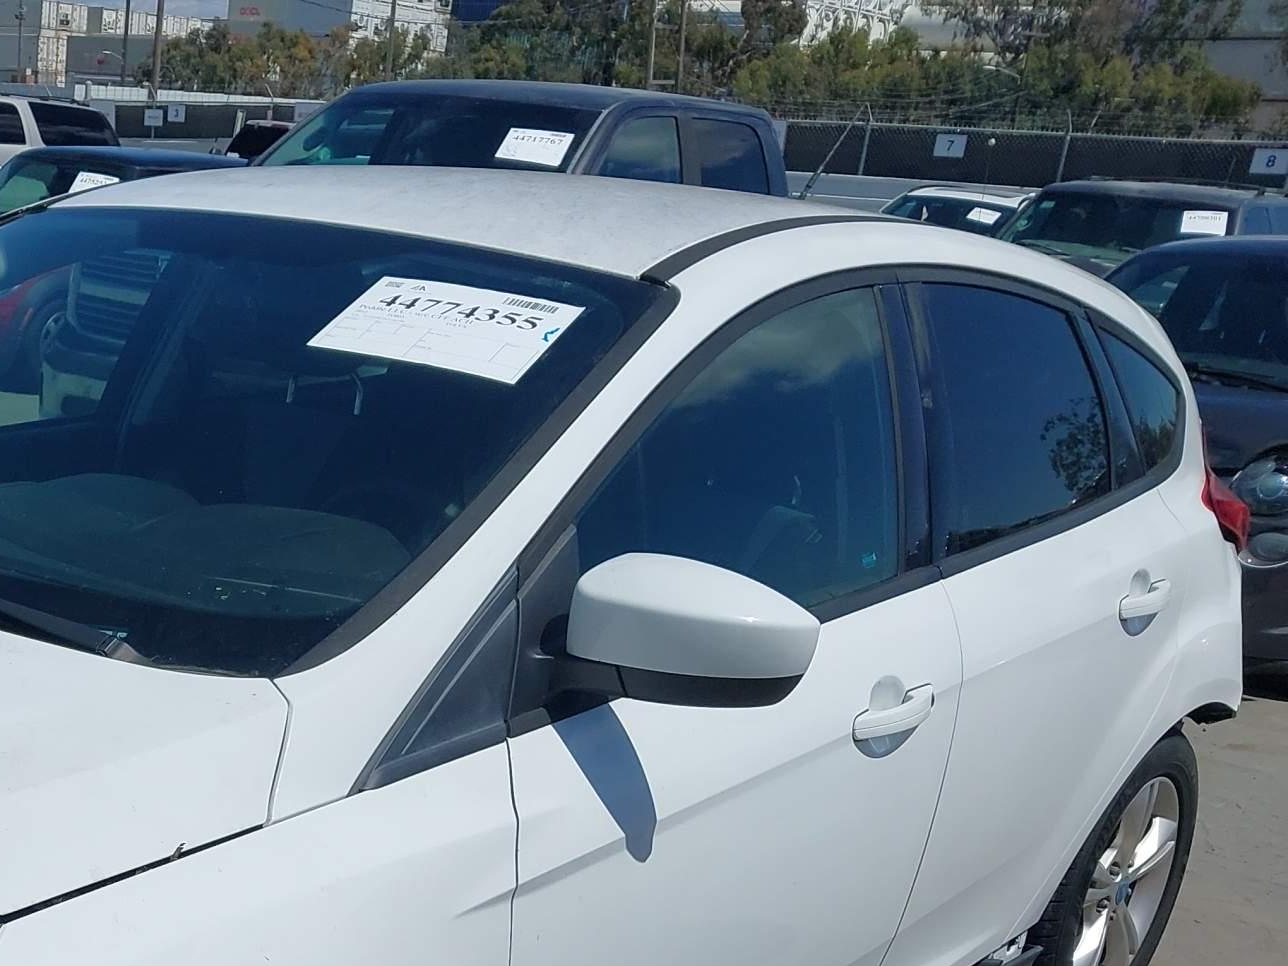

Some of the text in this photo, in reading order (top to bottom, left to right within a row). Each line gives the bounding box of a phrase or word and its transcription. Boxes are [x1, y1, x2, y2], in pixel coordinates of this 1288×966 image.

[946, 139, 955, 151] 7
[1265, 154, 1277, 168] 8
[379, 293, 544, 332] 44774355
